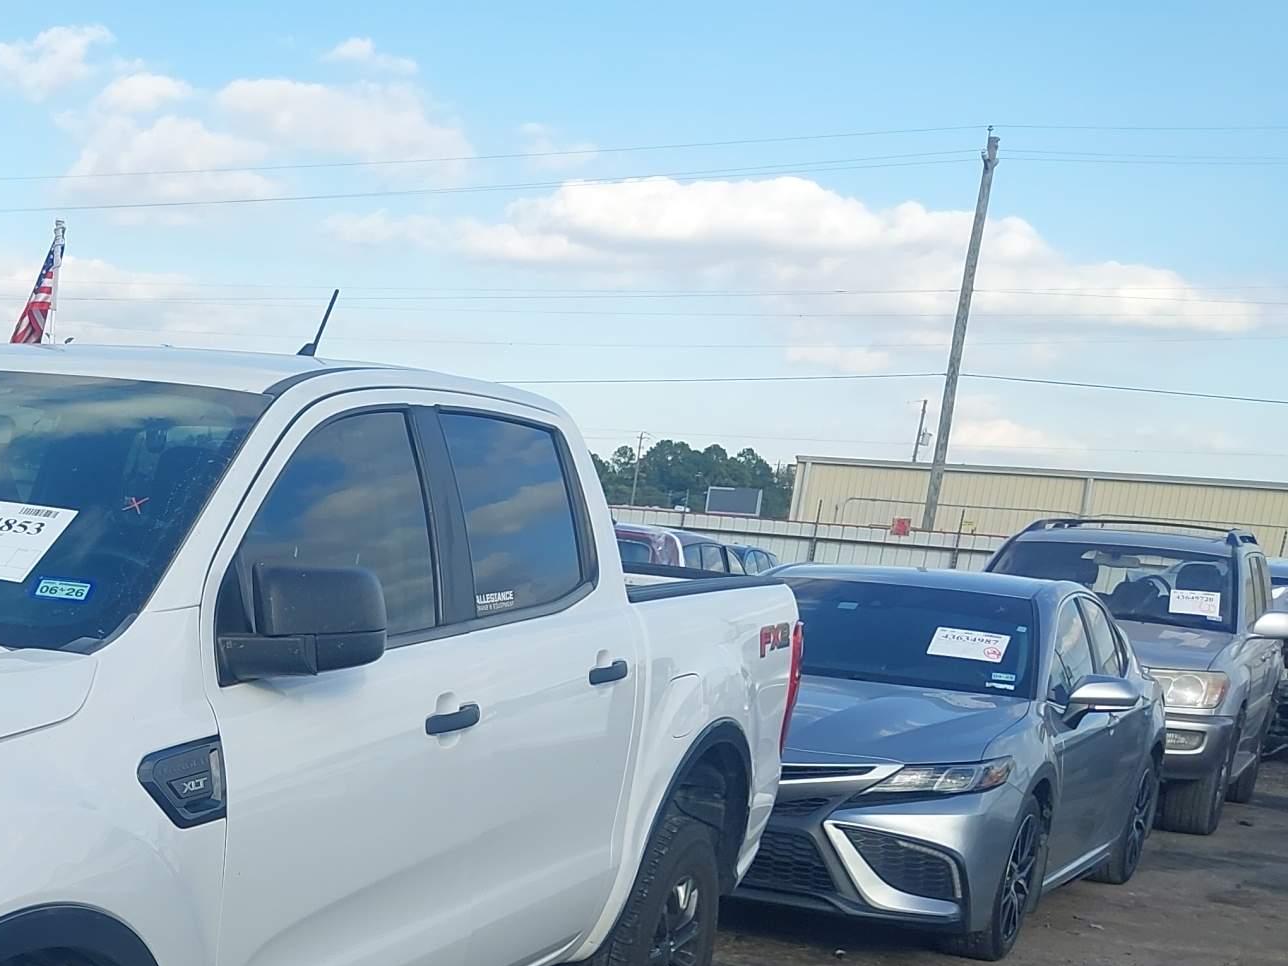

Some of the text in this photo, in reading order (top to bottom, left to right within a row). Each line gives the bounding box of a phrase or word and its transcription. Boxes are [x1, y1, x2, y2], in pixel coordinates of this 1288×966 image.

[39, 585, 86, 598] 06 26
[182, 777, 208, 795] XLT
